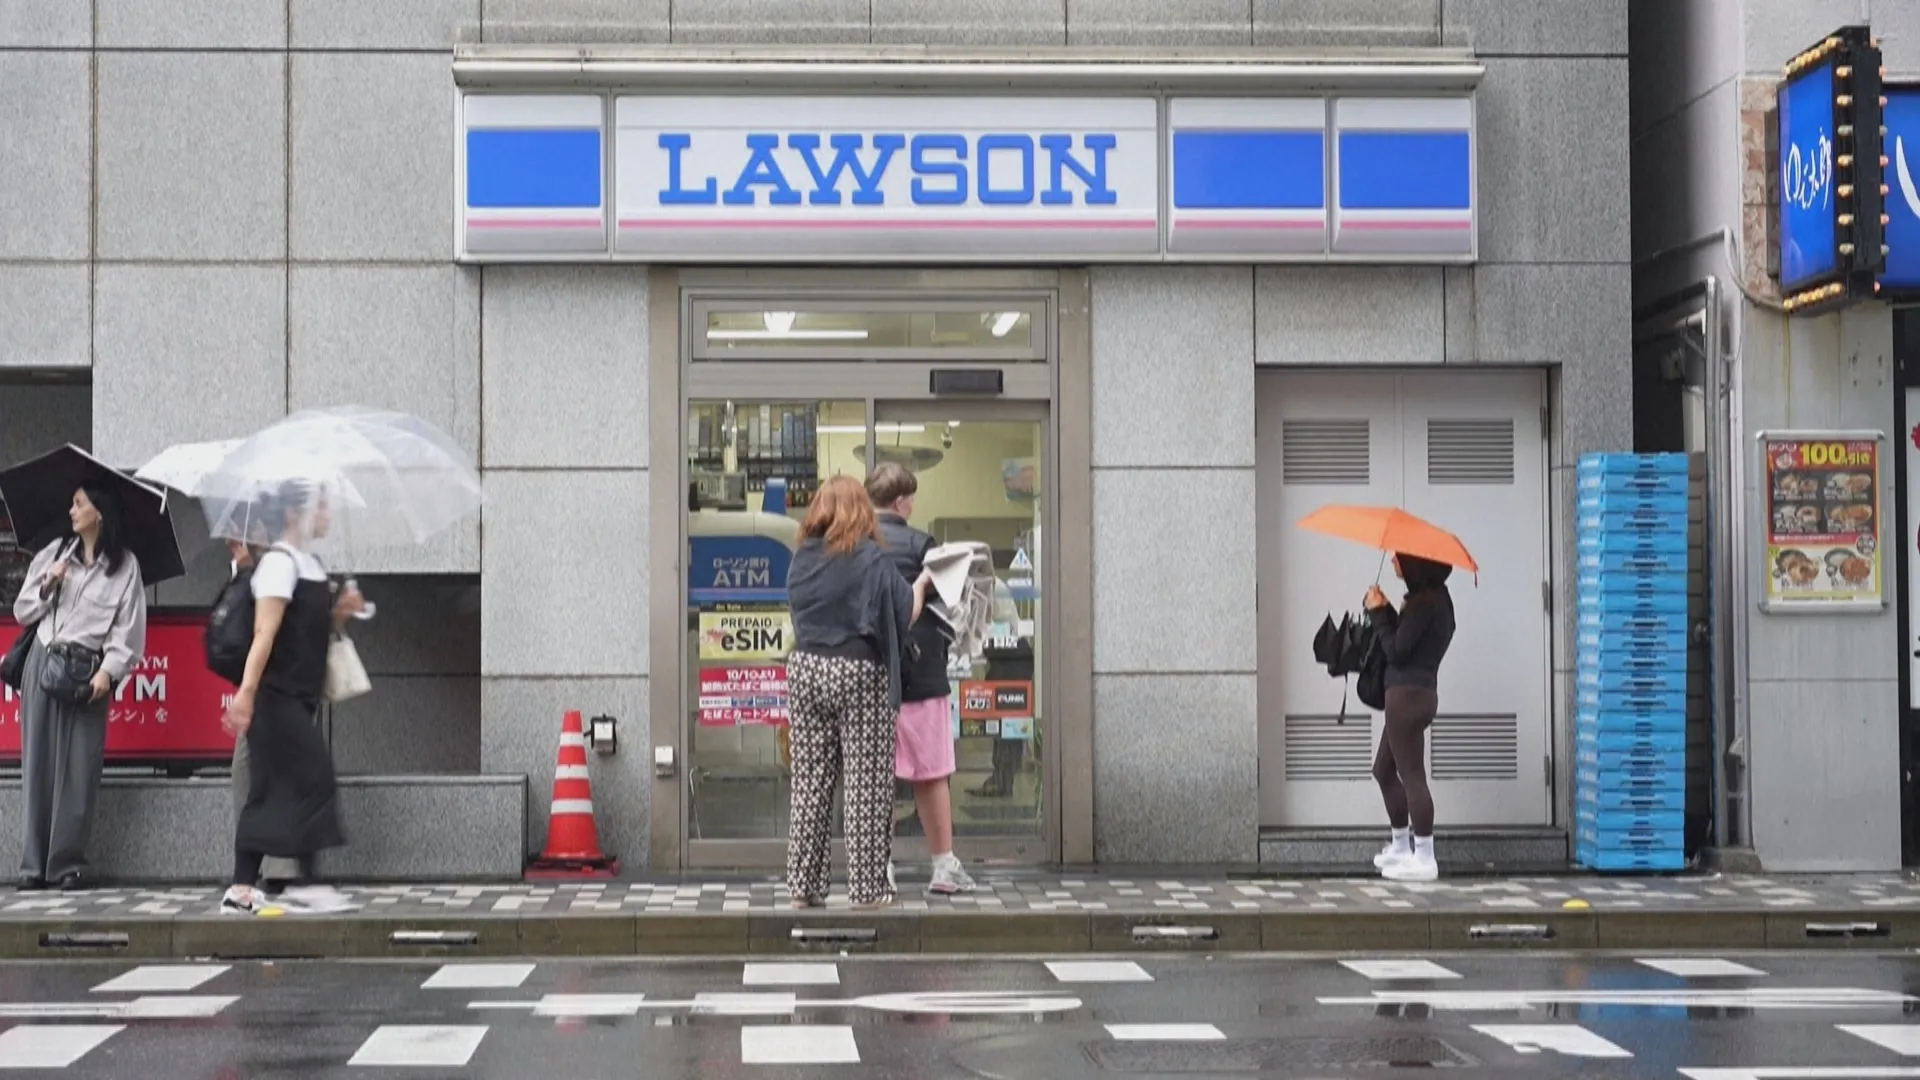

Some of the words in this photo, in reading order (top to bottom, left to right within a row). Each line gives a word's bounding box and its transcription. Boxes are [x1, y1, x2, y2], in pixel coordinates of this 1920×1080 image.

[657, 133, 1118, 208] LAWSON
[712, 556, 770, 569] ローソン銀行
[712, 569, 770, 588] ATM
[721, 617, 772, 629] PREPAID
[721, 629, 783, 651] eSIM
